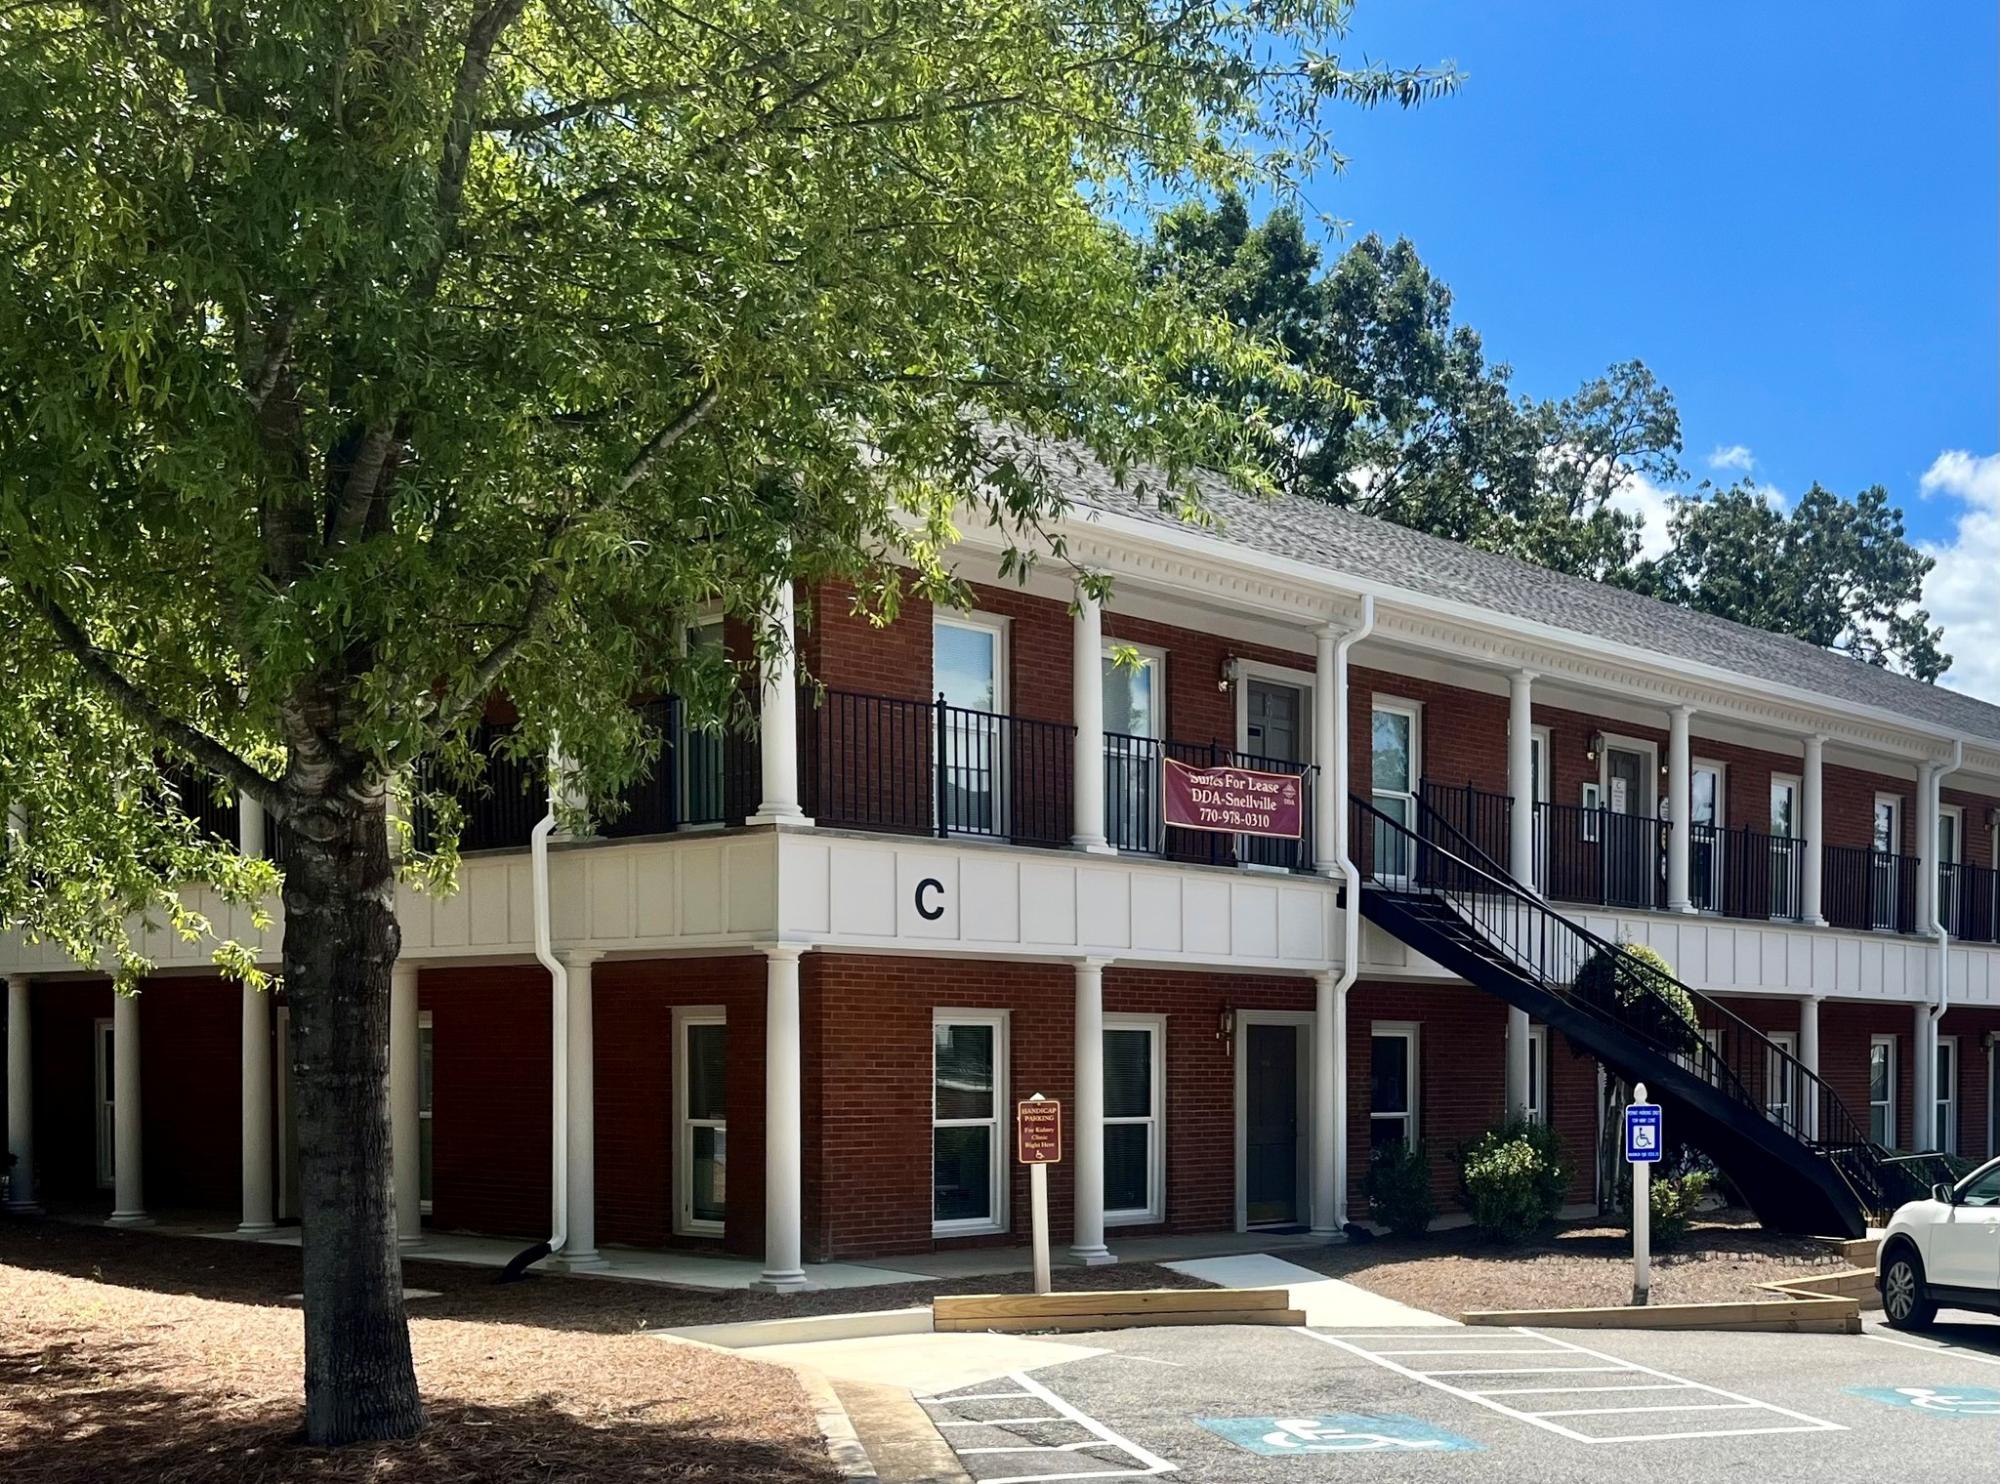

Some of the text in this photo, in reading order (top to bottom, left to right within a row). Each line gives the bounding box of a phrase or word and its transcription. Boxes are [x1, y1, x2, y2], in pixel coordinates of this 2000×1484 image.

[1189, 771, 1280, 794] Suites For Lease
[1191, 788, 1277, 811] DDA-Snellville
[1200, 808, 1270, 828] 770-978-0310
[915, 878, 944, 920] C
